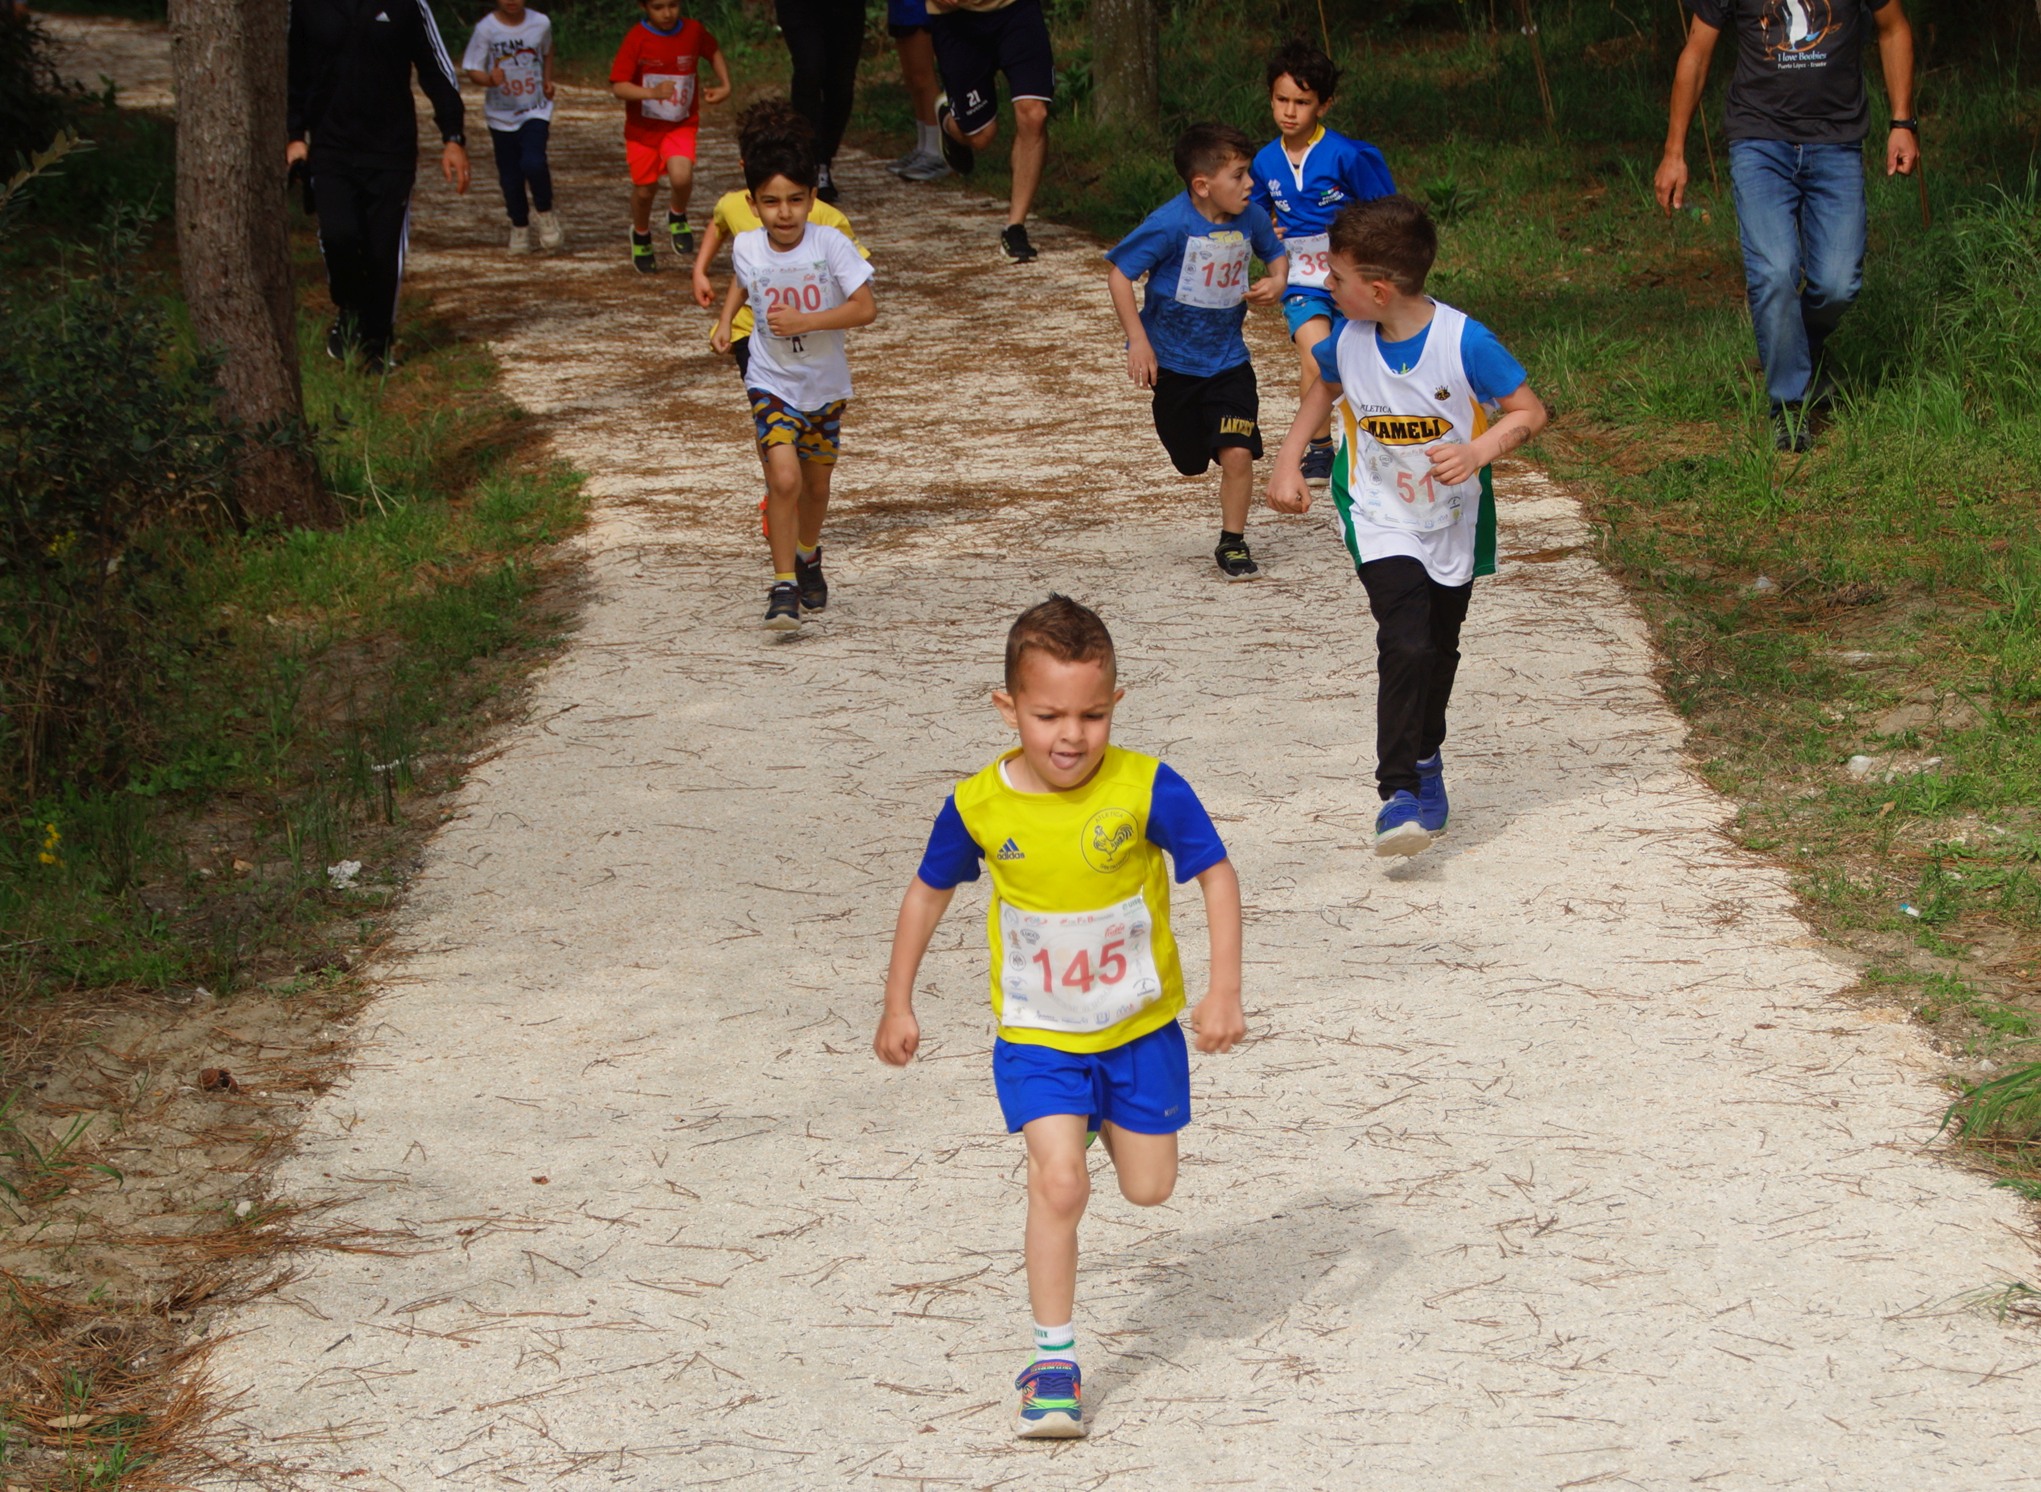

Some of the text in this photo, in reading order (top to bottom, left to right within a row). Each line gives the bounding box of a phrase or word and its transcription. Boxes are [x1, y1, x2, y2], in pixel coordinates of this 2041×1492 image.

[1782, 52, 1798, 62] love
[1799, 51, 1826, 60] Boobies
[500, 77, 536, 97] 395
[966, 89, 981, 107] 21
[1201, 260, 1243, 288] 132
[764, 284, 821, 312] 200
[1368, 419, 1441, 439] MAMELI
[1396, 470, 1436, 504] 51
[1095, 810, 1124, 824] ATLETICA
[997, 851, 1026, 860] adidas
[1032, 939, 1128, 994] 145
